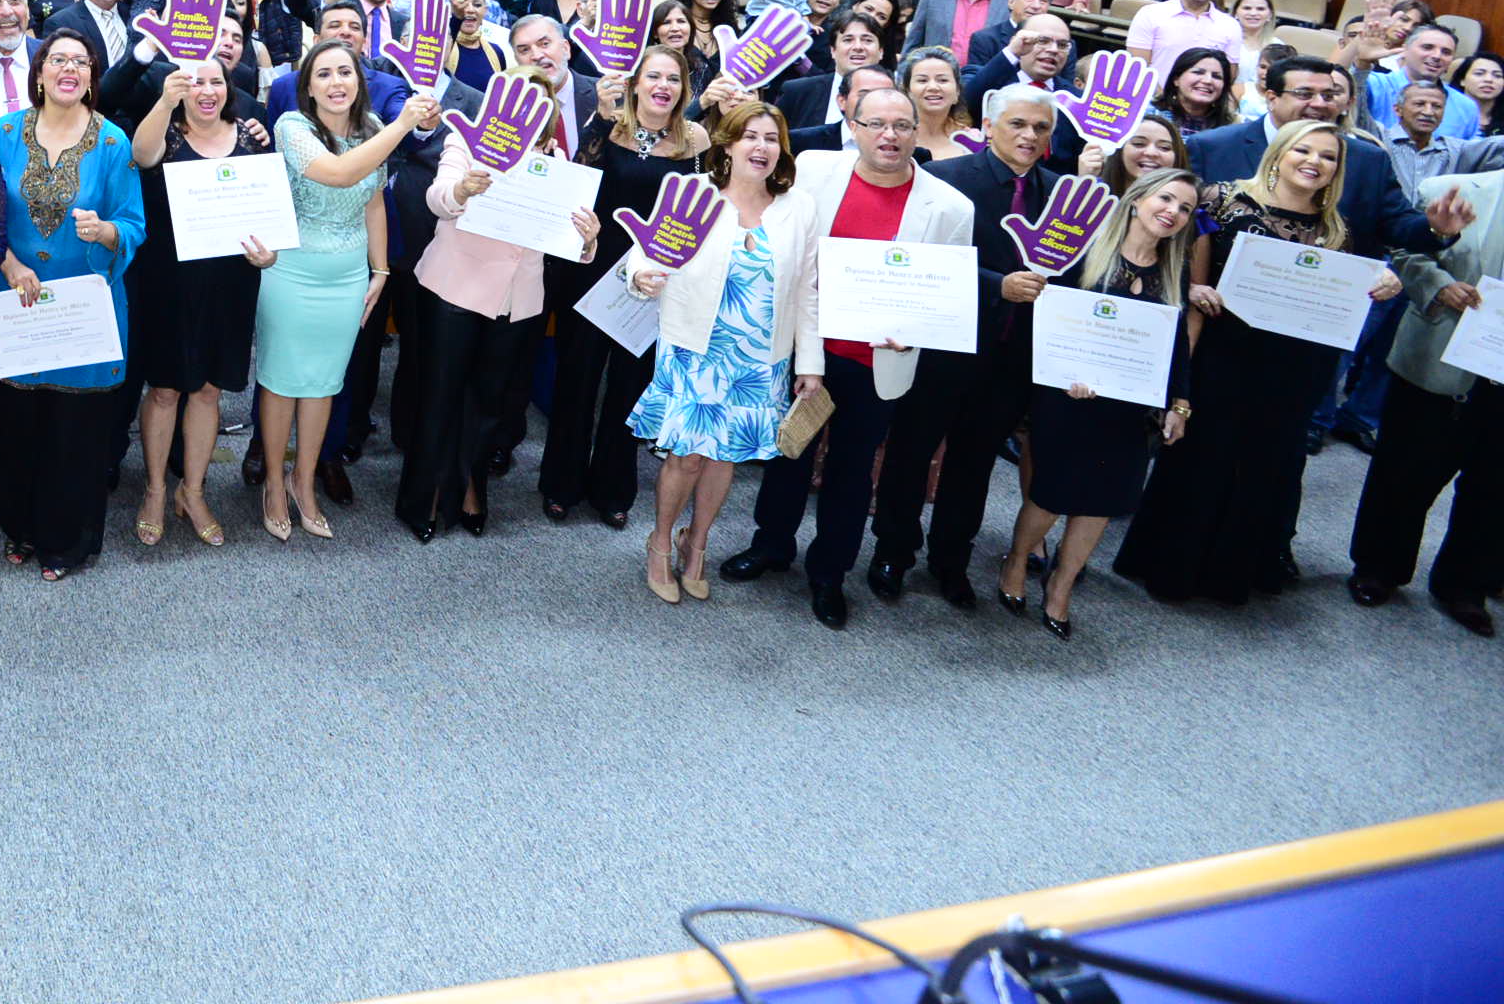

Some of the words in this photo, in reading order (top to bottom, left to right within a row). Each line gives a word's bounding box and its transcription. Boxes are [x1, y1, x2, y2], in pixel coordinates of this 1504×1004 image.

[171, 30, 192, 38] dessa
[187, 22, 214, 32] desista
[603, 22, 610, 30] O
[612, 40, 637, 49] Família
[1093, 92, 1131, 108] Família
[1088, 109, 1117, 124] tudo!
[1090, 100, 1114, 113] base
[1114, 108, 1128, 118] de
[489, 116, 498, 124] O
[496, 121, 518, 132] amor
[482, 131, 511, 147] começa
[510, 143, 522, 152] na
[486, 124, 497, 132] da
[496, 128, 522, 143] pátria
[480, 136, 506, 153] Família
[660, 222, 671, 231] da
[670, 228, 696, 240] pátria
[670, 220, 693, 231] amor
[1050, 218, 1084, 236] Família
[656, 229, 686, 245] começa
[1044, 228, 1067, 240] meu
[653, 234, 682, 251] Família
[1040, 237, 1078, 254] alicerce!
